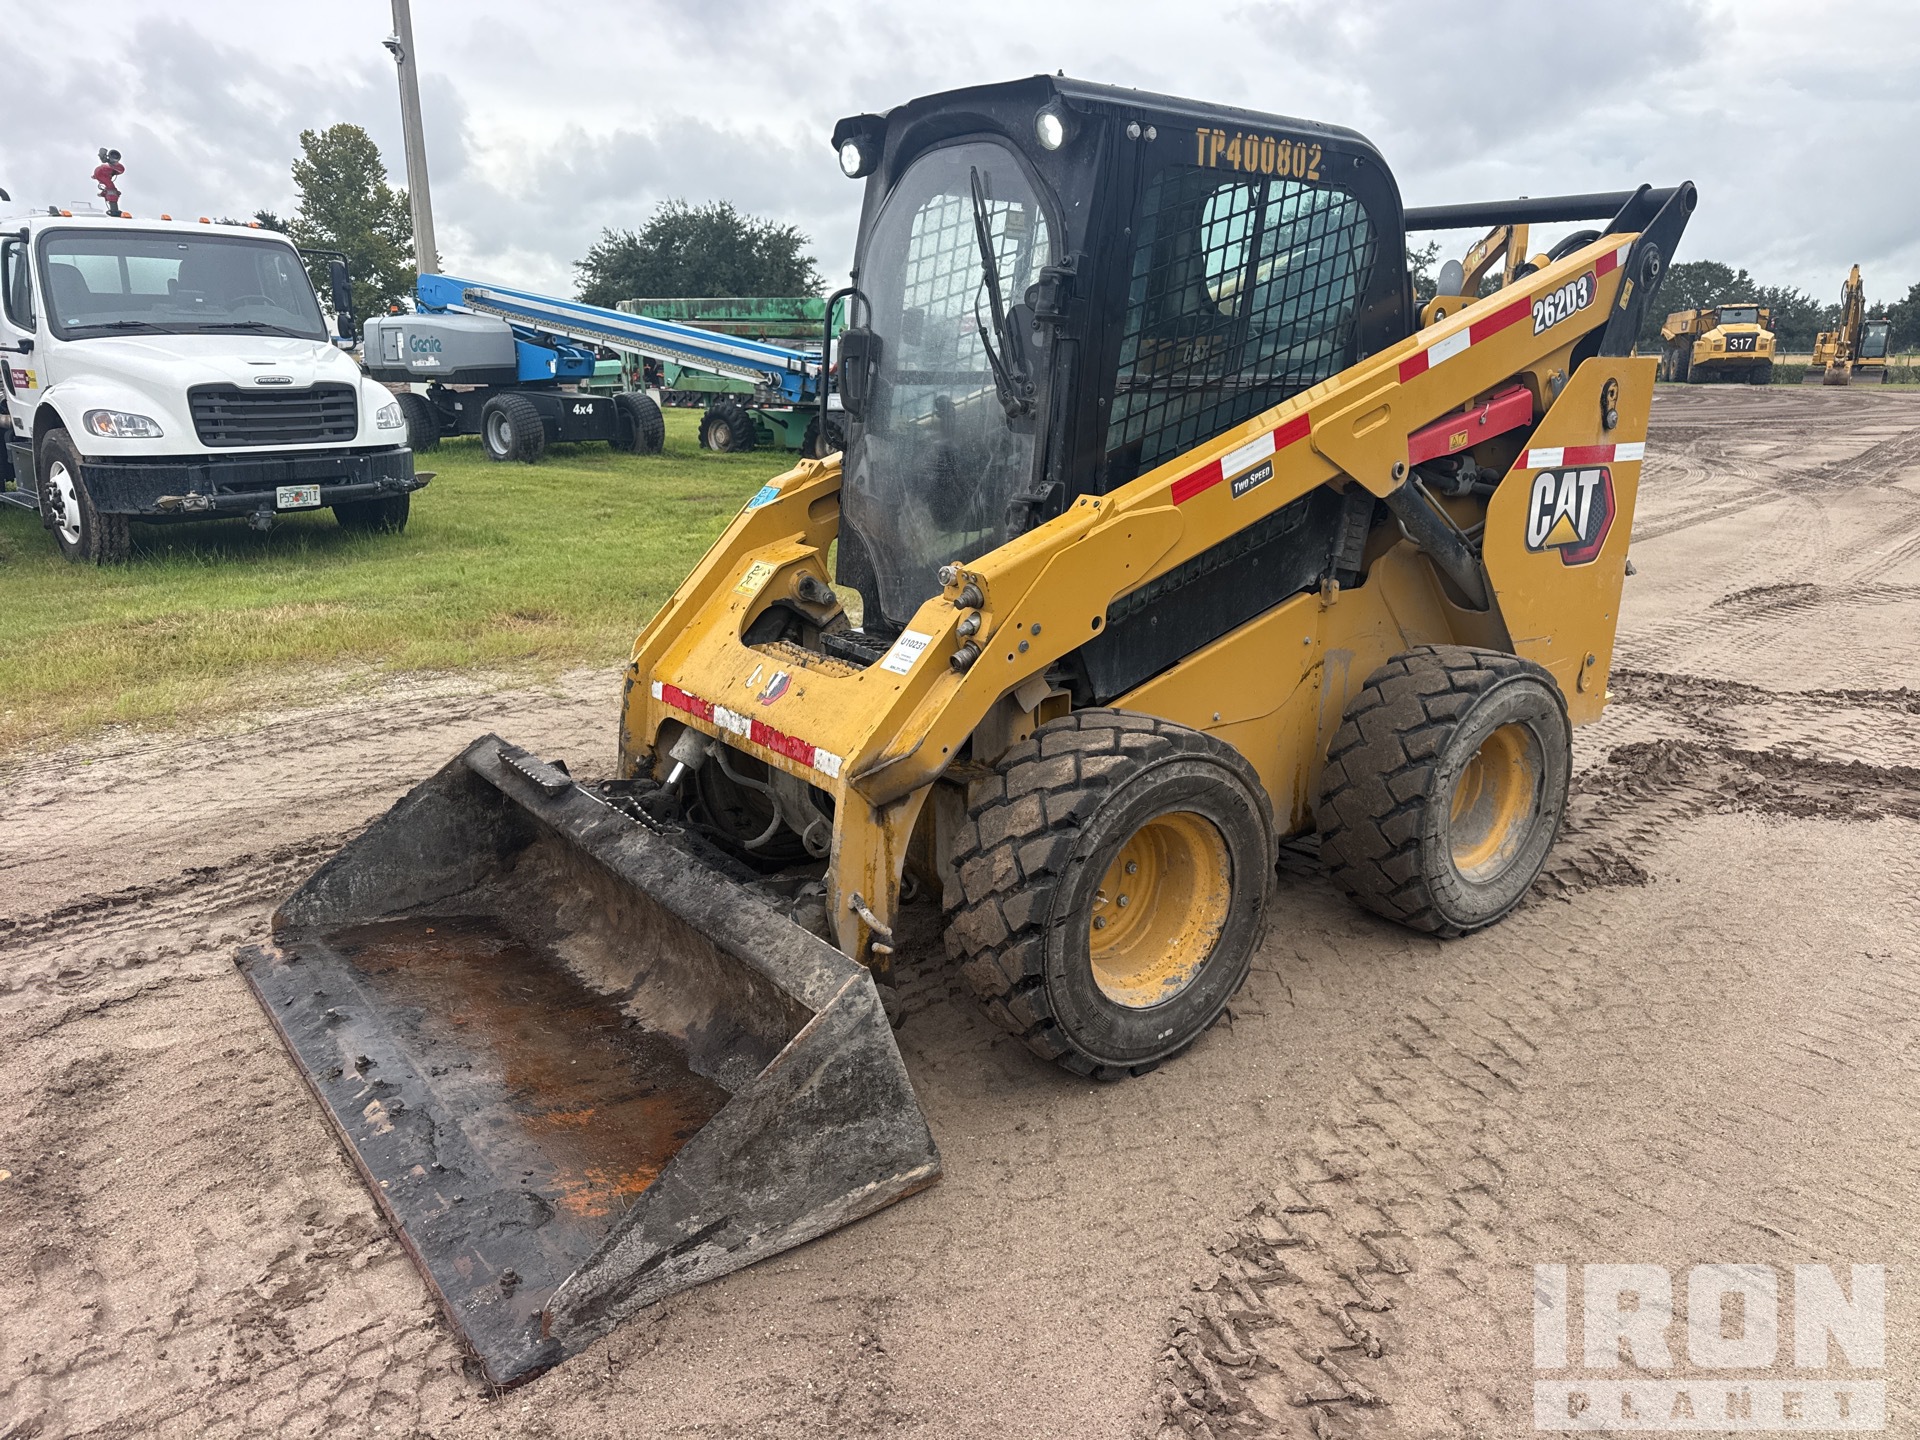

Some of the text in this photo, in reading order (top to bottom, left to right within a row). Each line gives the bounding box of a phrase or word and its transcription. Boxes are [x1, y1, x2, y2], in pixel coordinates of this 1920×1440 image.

[1195, 127, 1322, 180] TP400802
[1532, 276, 1588, 334] 262D3
[409, 334, 442, 353] Genie
[1729, 338, 1753, 350] 317
[572, 403, 594, 415] 4x4
[1527, 469, 1601, 548] CAT
